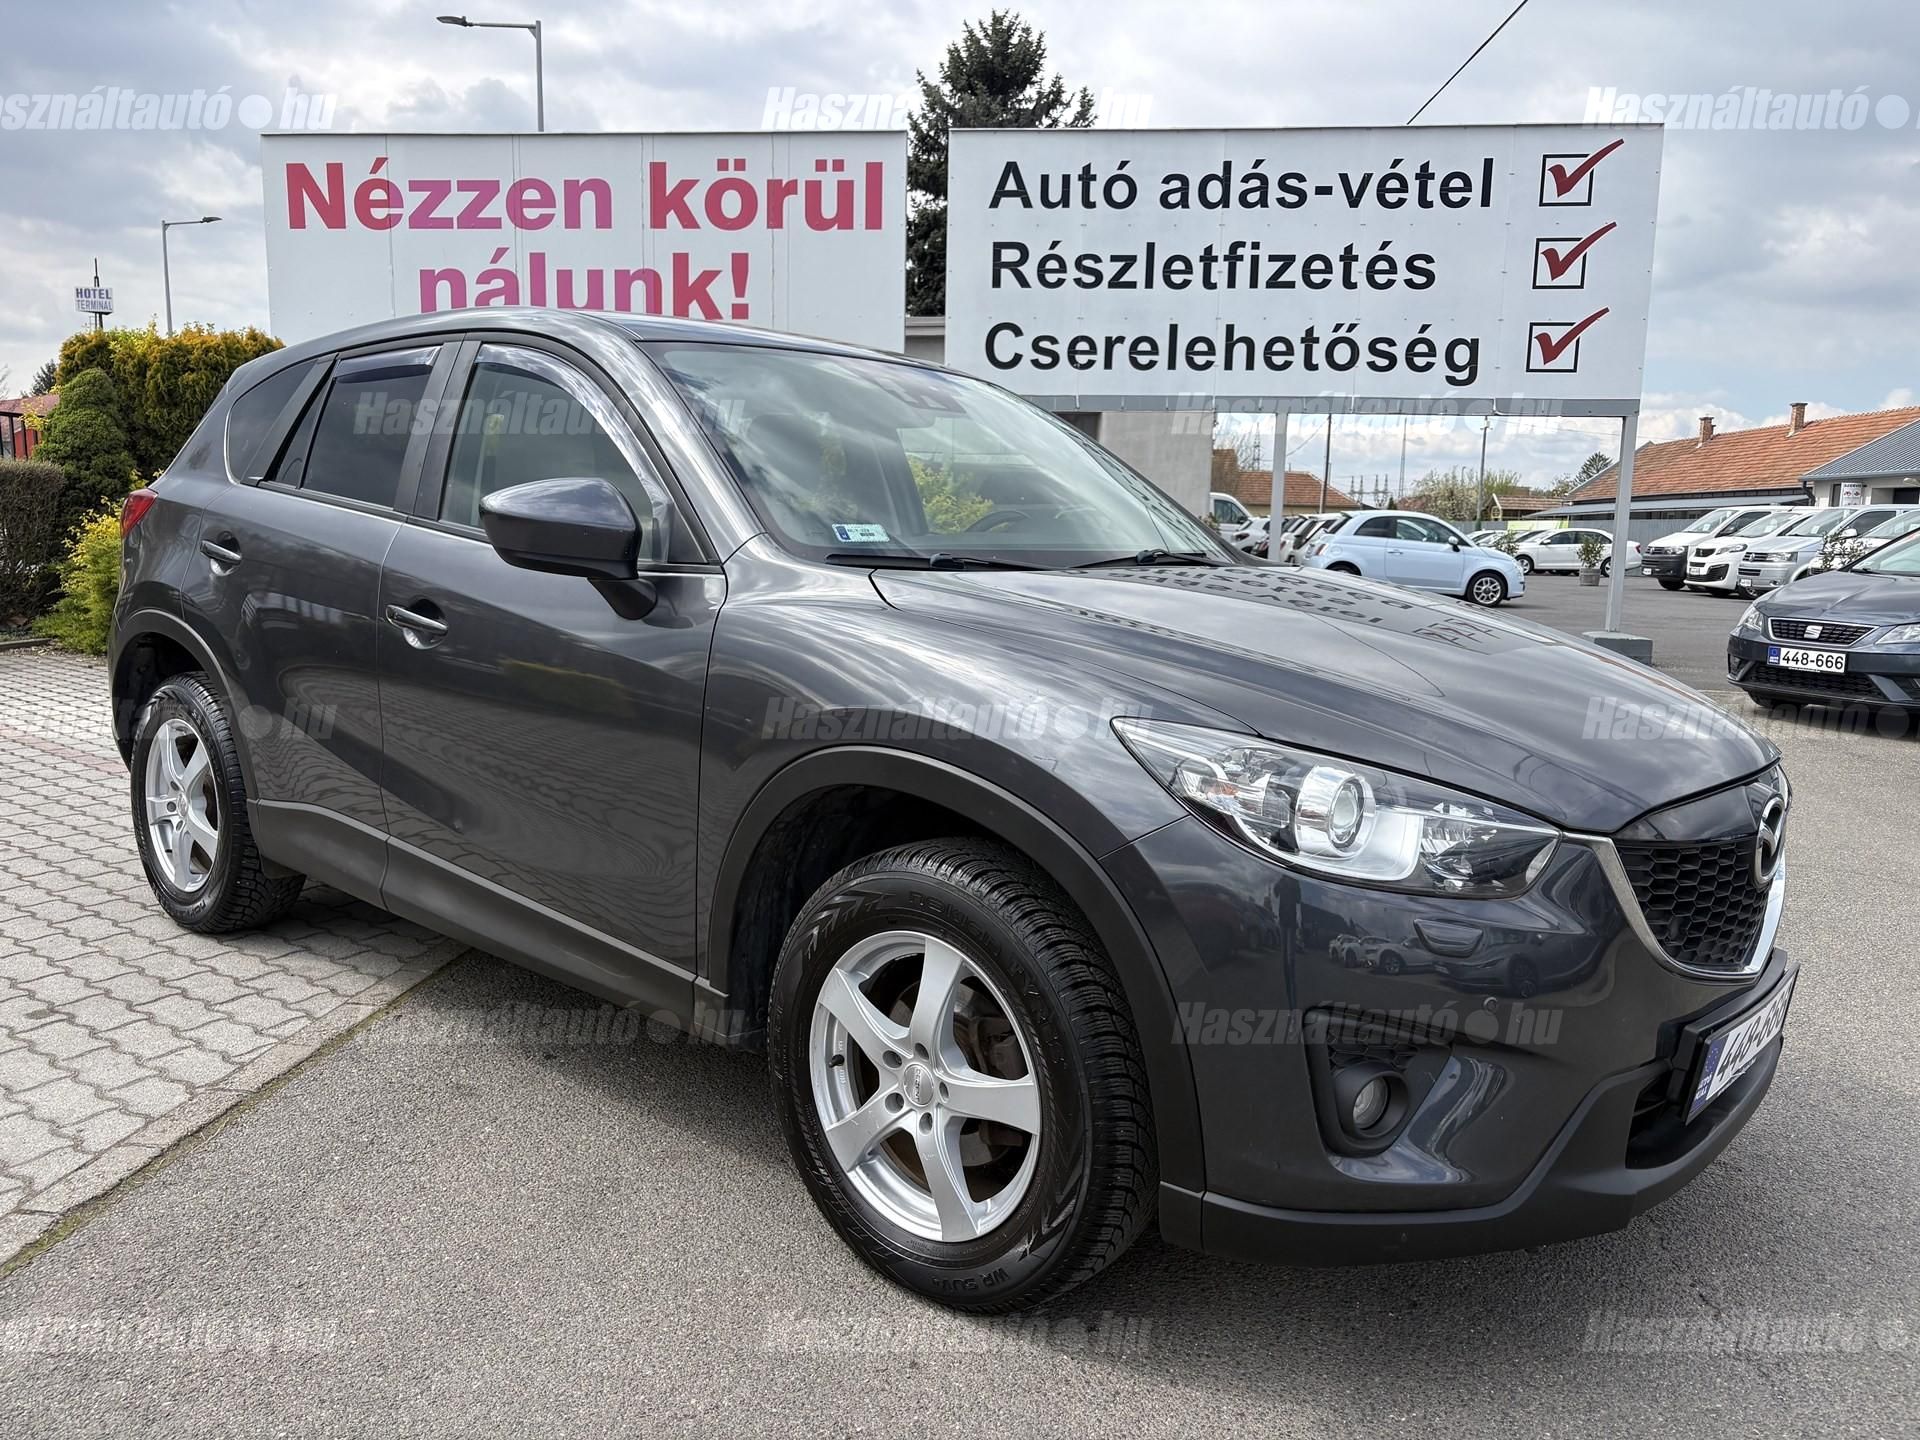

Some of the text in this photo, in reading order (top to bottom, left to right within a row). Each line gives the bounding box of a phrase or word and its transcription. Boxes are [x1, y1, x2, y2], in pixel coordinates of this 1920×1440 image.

[286, 157, 884, 231] Nézzen körül
[988, 158, 1495, 209] Autó adás-vétel
[419, 247, 749, 320] nálunk!
[991, 240, 1437, 290] Részletfizetés
[76, 288, 112, 299] HOTEL
[76, 299, 112, 311] TERMINAL
[985, 322, 1481, 386] Cserelehetőség
[1782, 650, 1844, 670] 448-666
[1717, 981, 1793, 1082] 448-666
